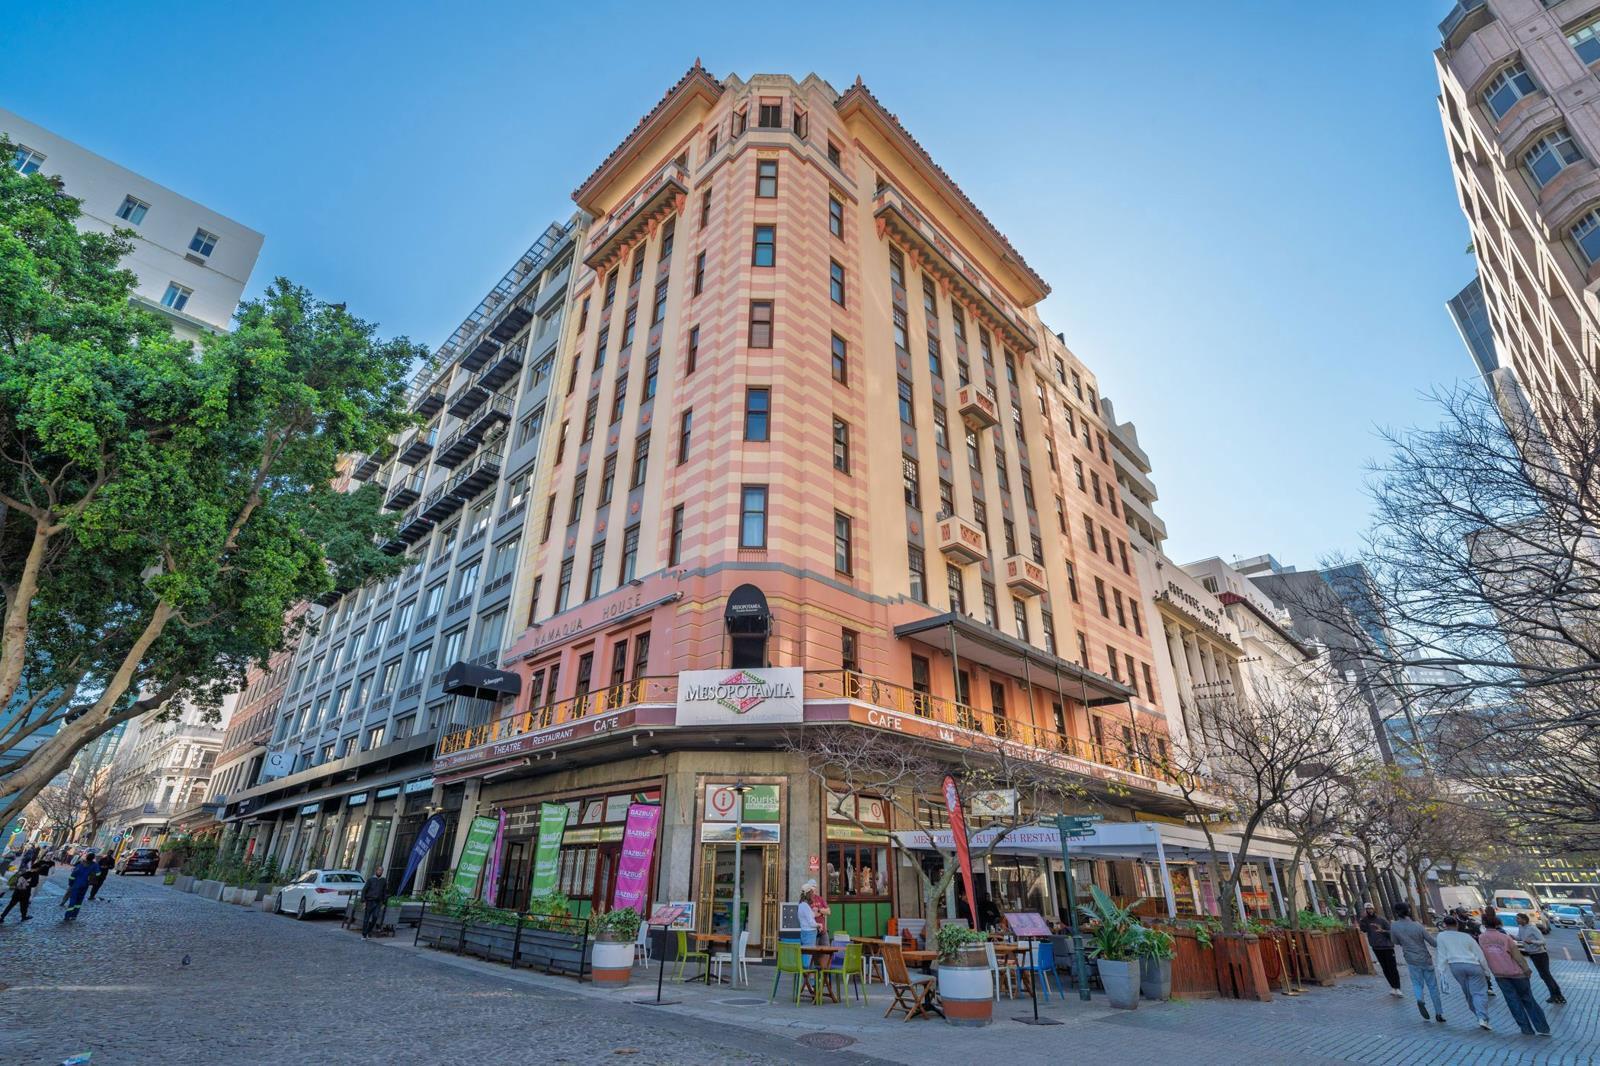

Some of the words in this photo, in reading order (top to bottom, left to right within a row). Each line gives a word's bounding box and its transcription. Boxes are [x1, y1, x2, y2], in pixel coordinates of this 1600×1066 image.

[535, 617, 583, 647] NAMAQUA
[602, 593, 641, 619] HOUSE
[685, 682, 796, 702] MESOPOTAMIA
[593, 717, 619, 732] CAFE
[868, 710, 902, 730] CAFE
[532, 729, 574, 745] RESTAURANT
[493, 741, 522, 755] THEATRE
[1049, 759, 1092, 776] RESTAURANT
[1020, 832, 1087, 843] RESTAUANT
